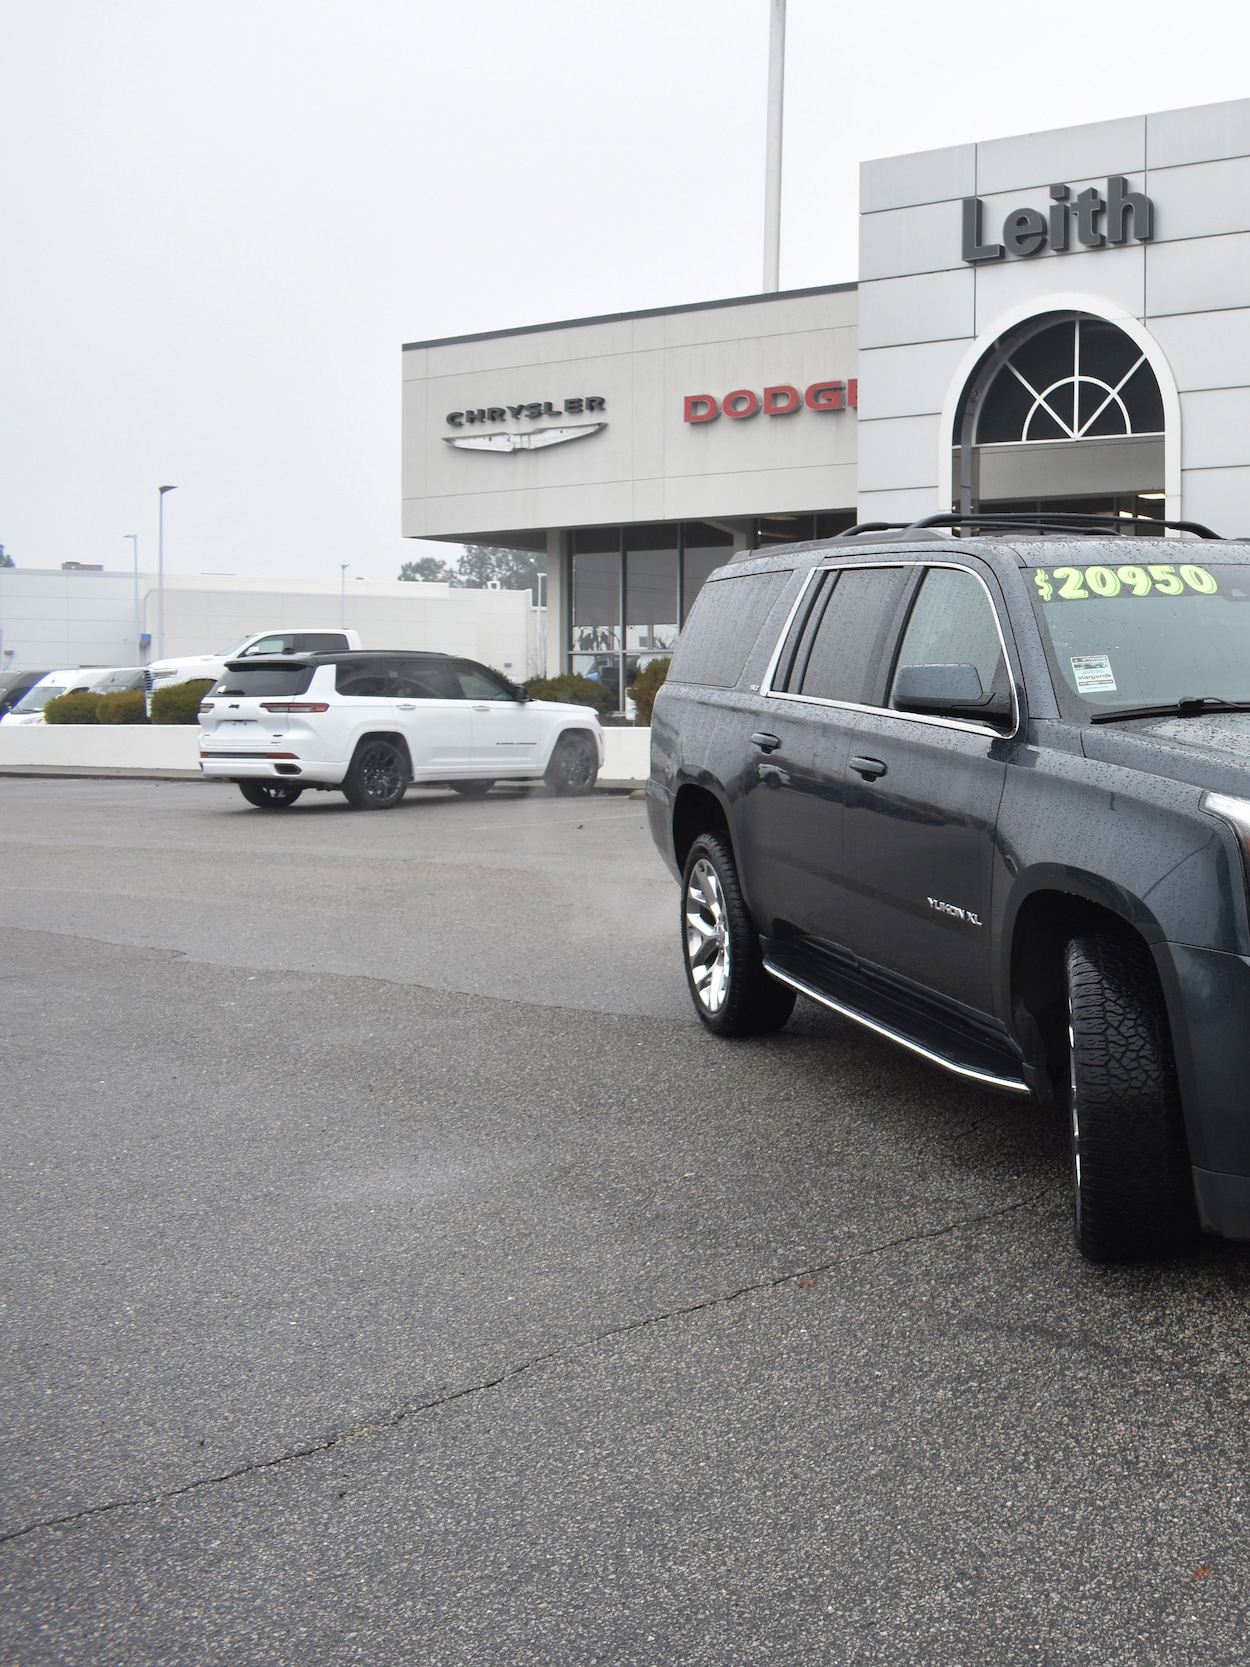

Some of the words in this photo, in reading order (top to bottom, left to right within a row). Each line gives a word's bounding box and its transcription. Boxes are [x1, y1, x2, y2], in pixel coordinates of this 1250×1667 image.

[961, 175, 1155, 264] Leith
[445, 395, 607, 428] CHRYSLER
[1034, 564, 1218, 602] $20950
[927, 896, 965, 920] YUKON
[966, 910, 983, 926] XL
